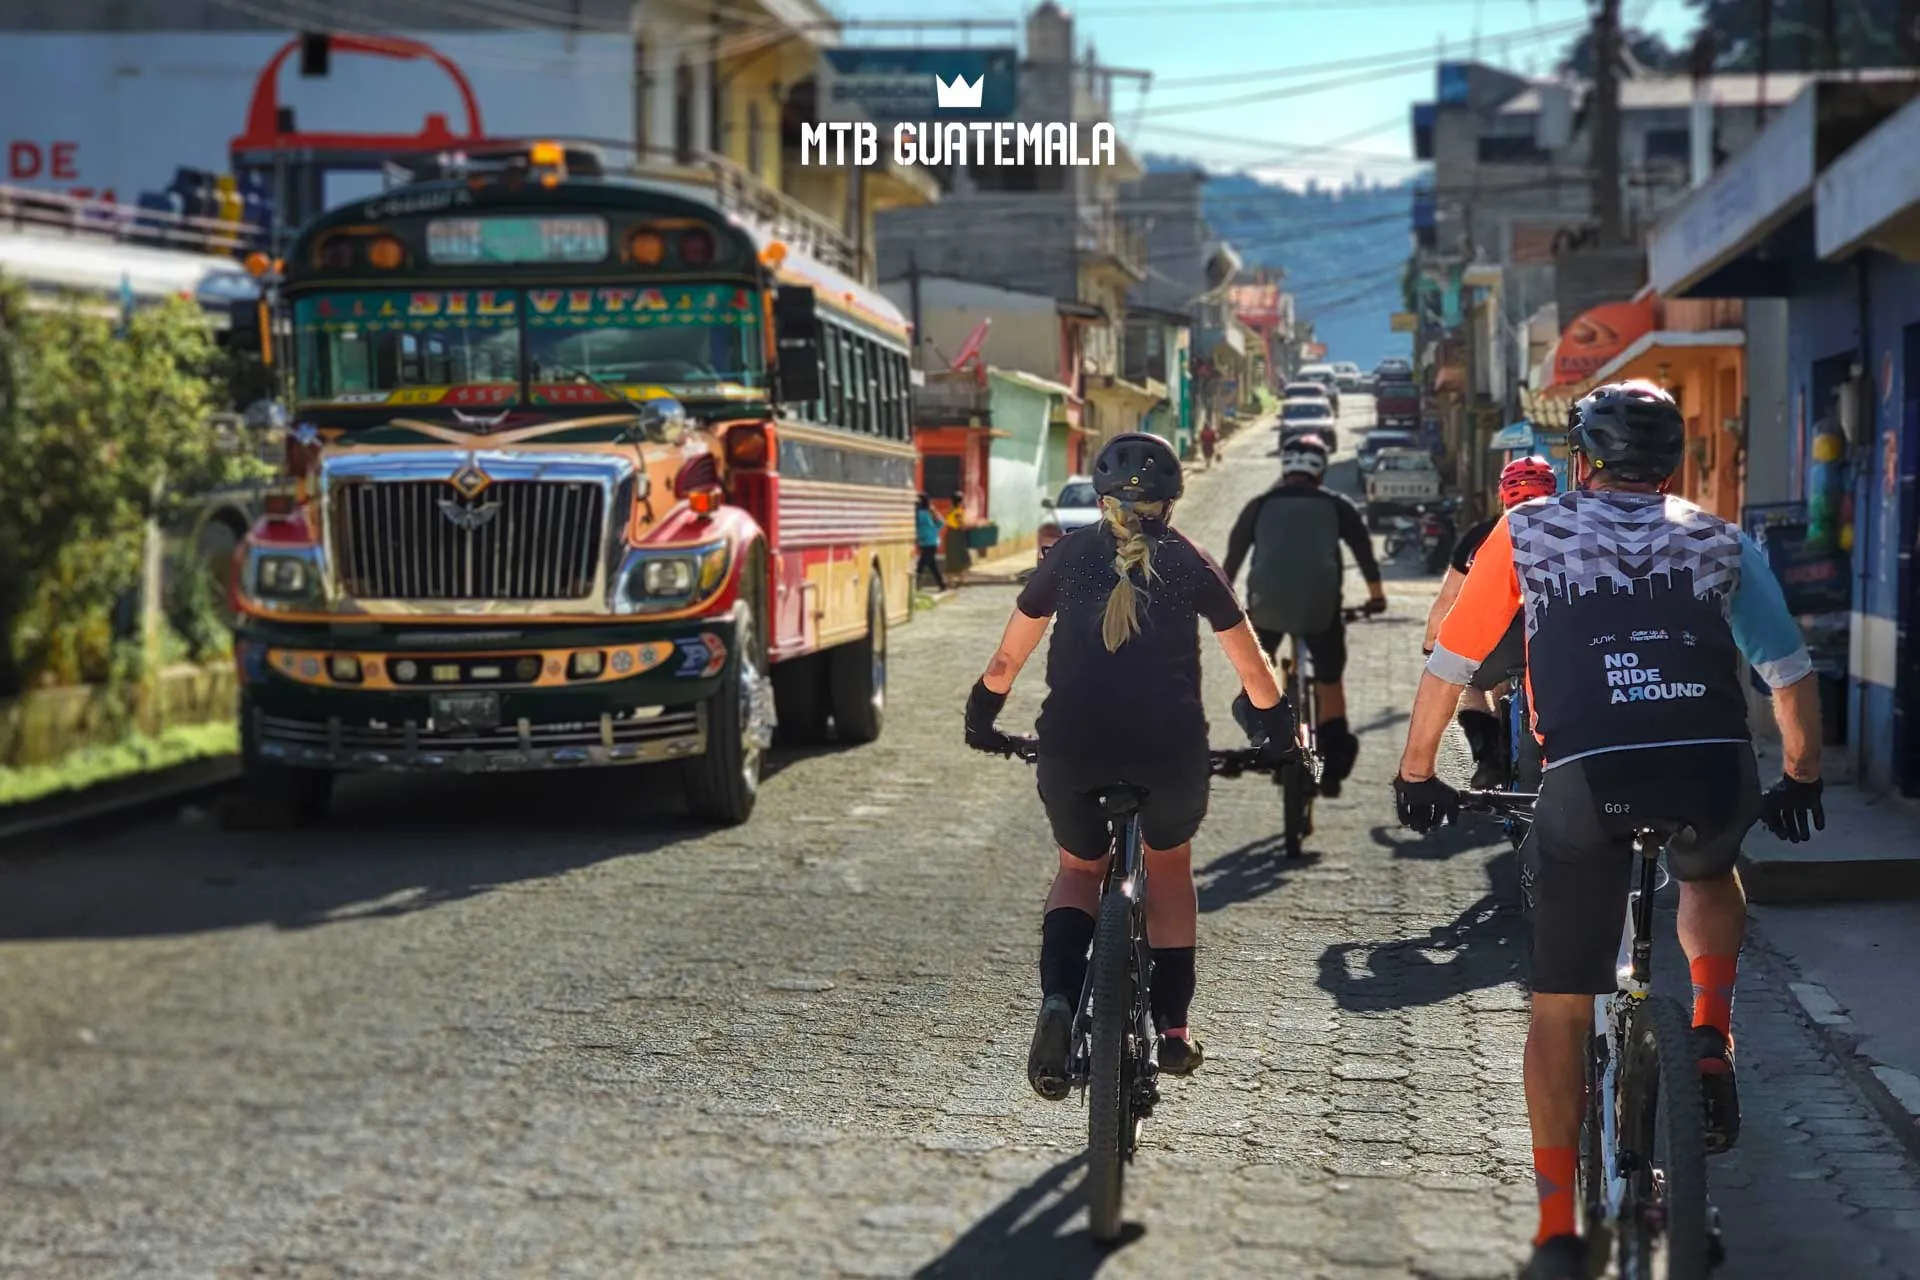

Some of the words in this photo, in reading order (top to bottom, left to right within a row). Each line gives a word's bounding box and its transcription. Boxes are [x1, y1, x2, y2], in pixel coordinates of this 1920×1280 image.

[9, 141, 80, 180] DE
[1604, 652, 1639, 669] NO
[1606, 668, 1661, 686] RIDE
[1611, 682, 1706, 704] AROUND
